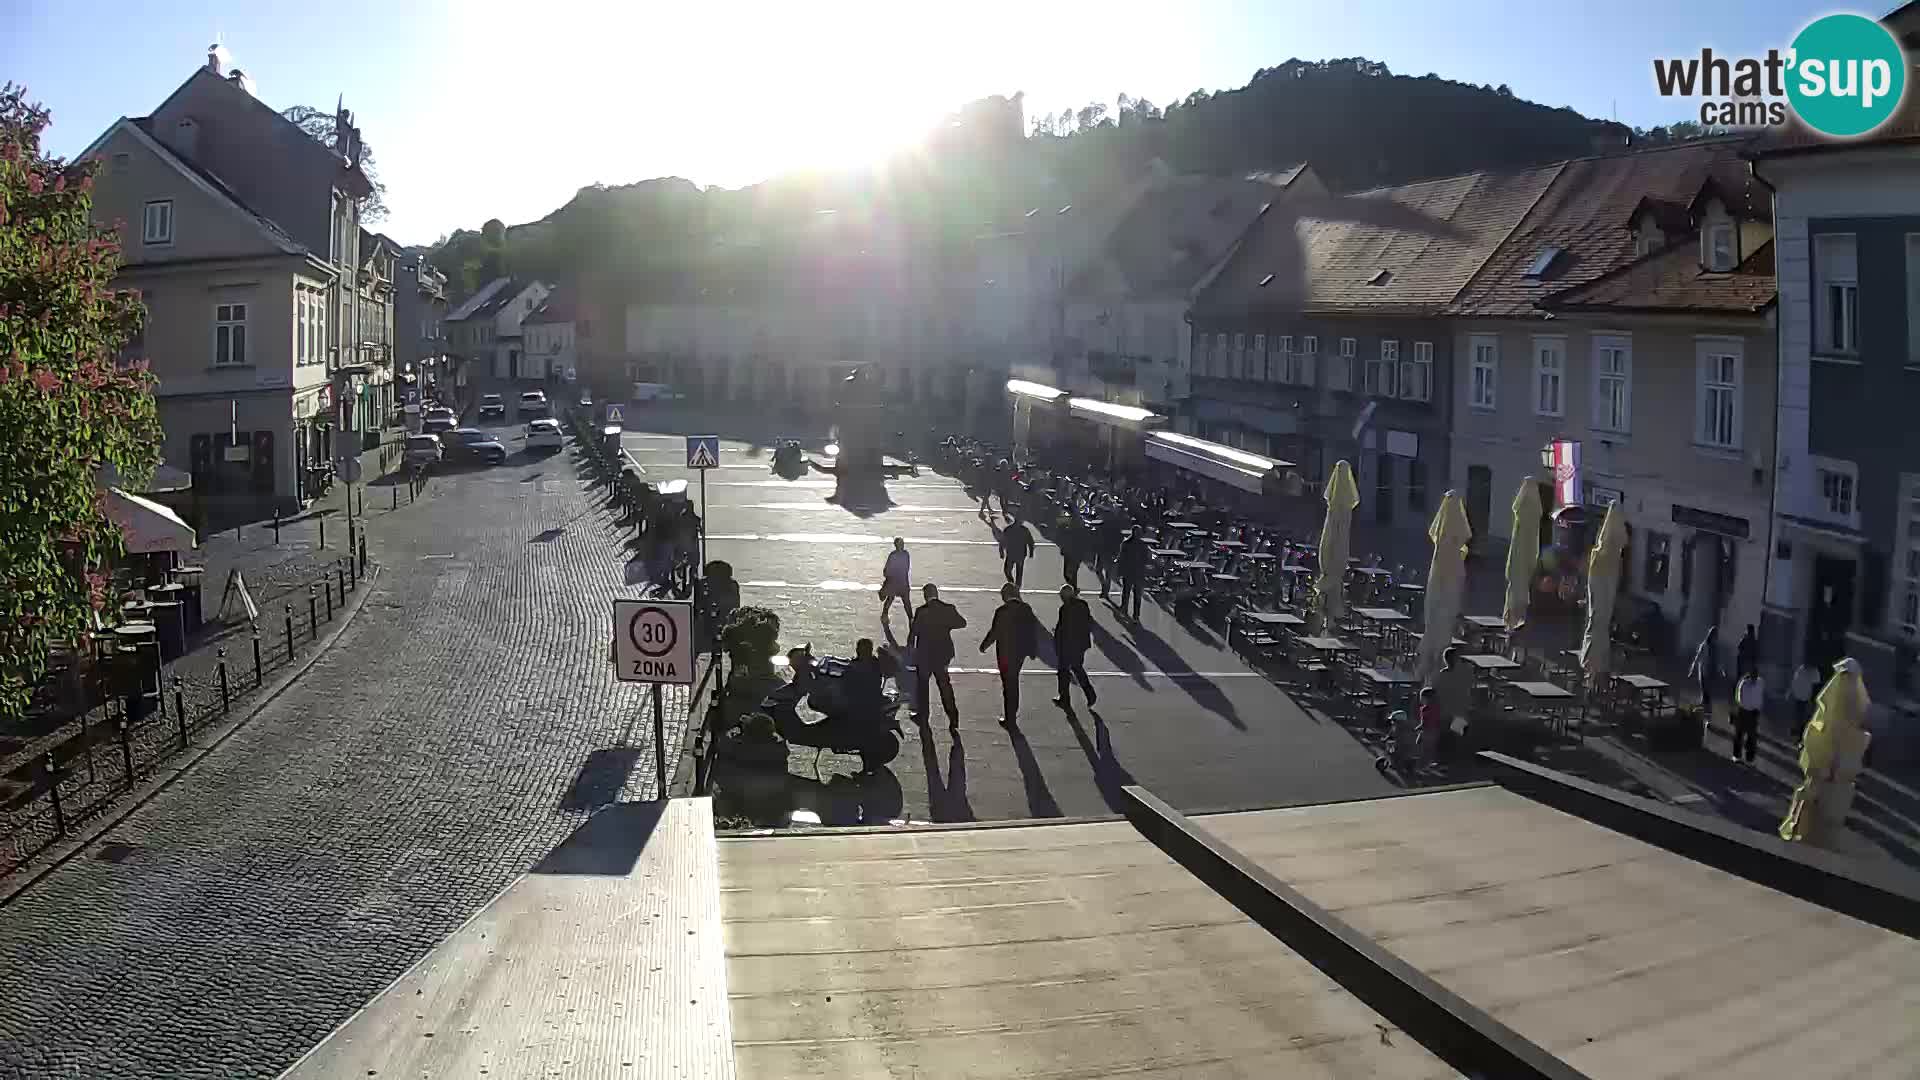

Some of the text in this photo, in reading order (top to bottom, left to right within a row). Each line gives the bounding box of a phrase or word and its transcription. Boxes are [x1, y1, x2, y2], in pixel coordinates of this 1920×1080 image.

[408, 391, 417, 402] P
[641, 622, 666, 644] 30
[632, 660, 677, 677] ZONA
